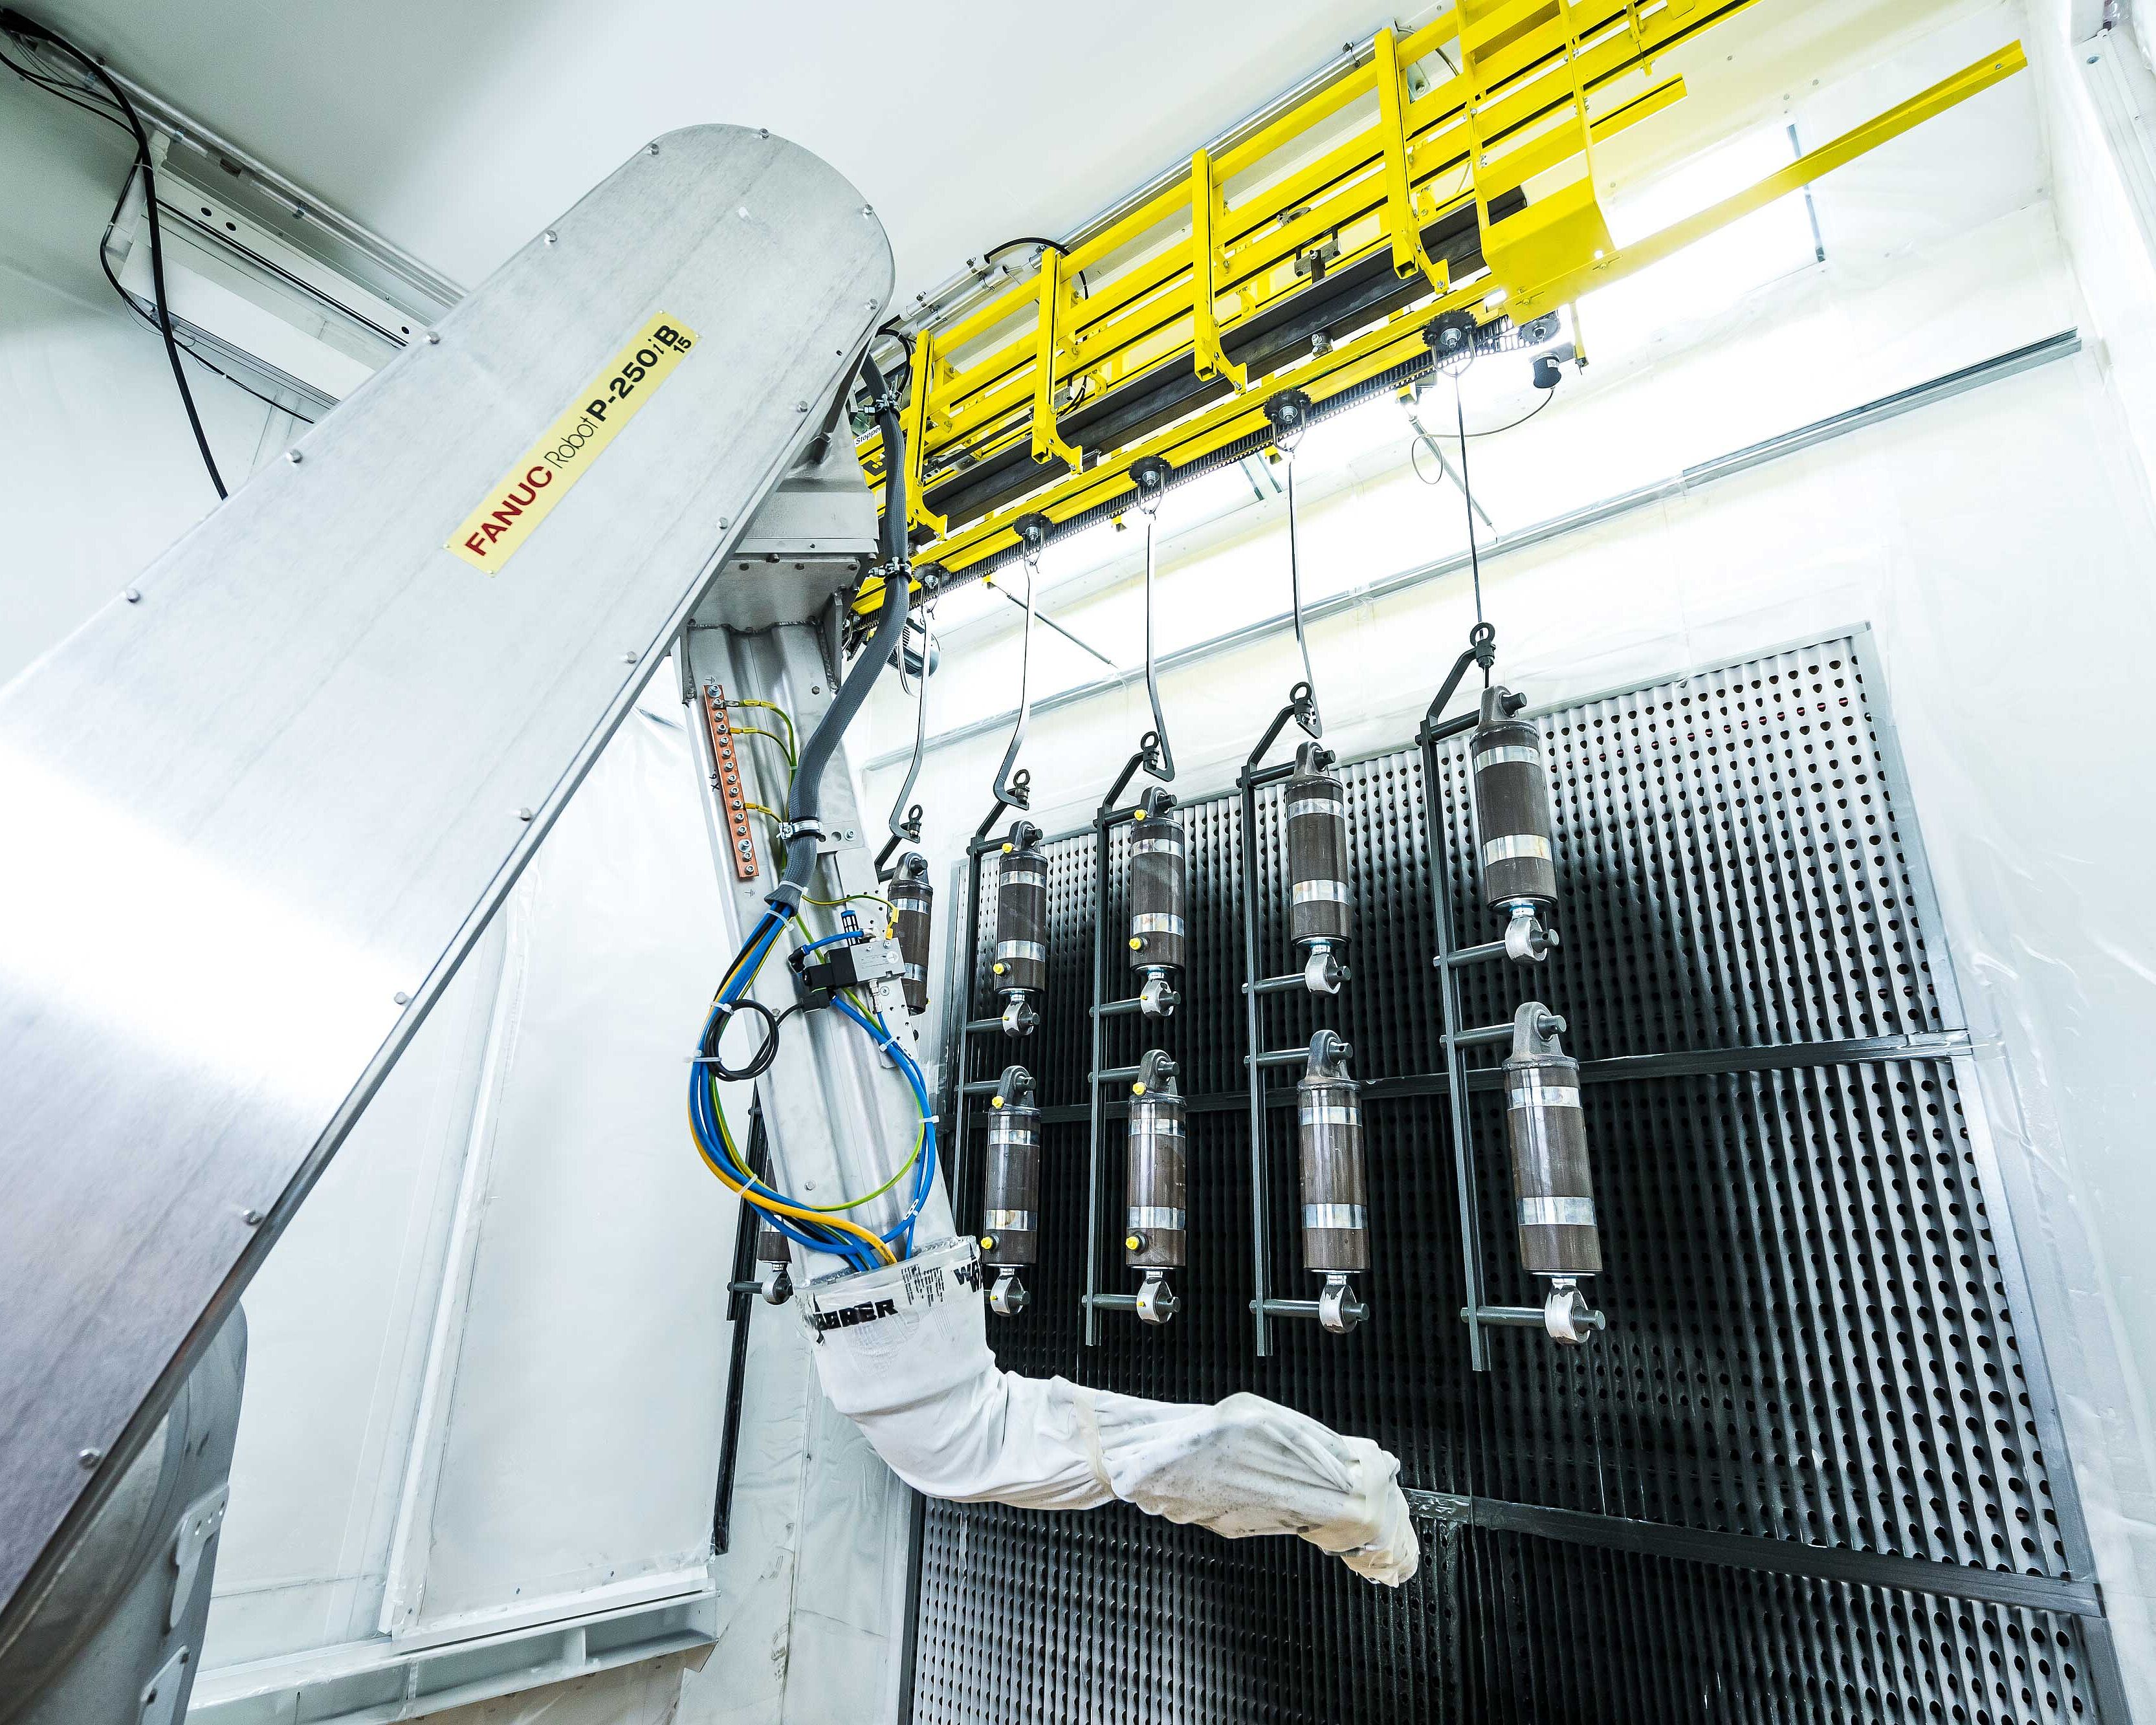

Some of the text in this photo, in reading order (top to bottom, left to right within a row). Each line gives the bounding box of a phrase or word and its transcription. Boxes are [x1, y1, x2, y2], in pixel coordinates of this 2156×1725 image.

[465, 325, 692, 556] FANUC Robot P-250iB 15
